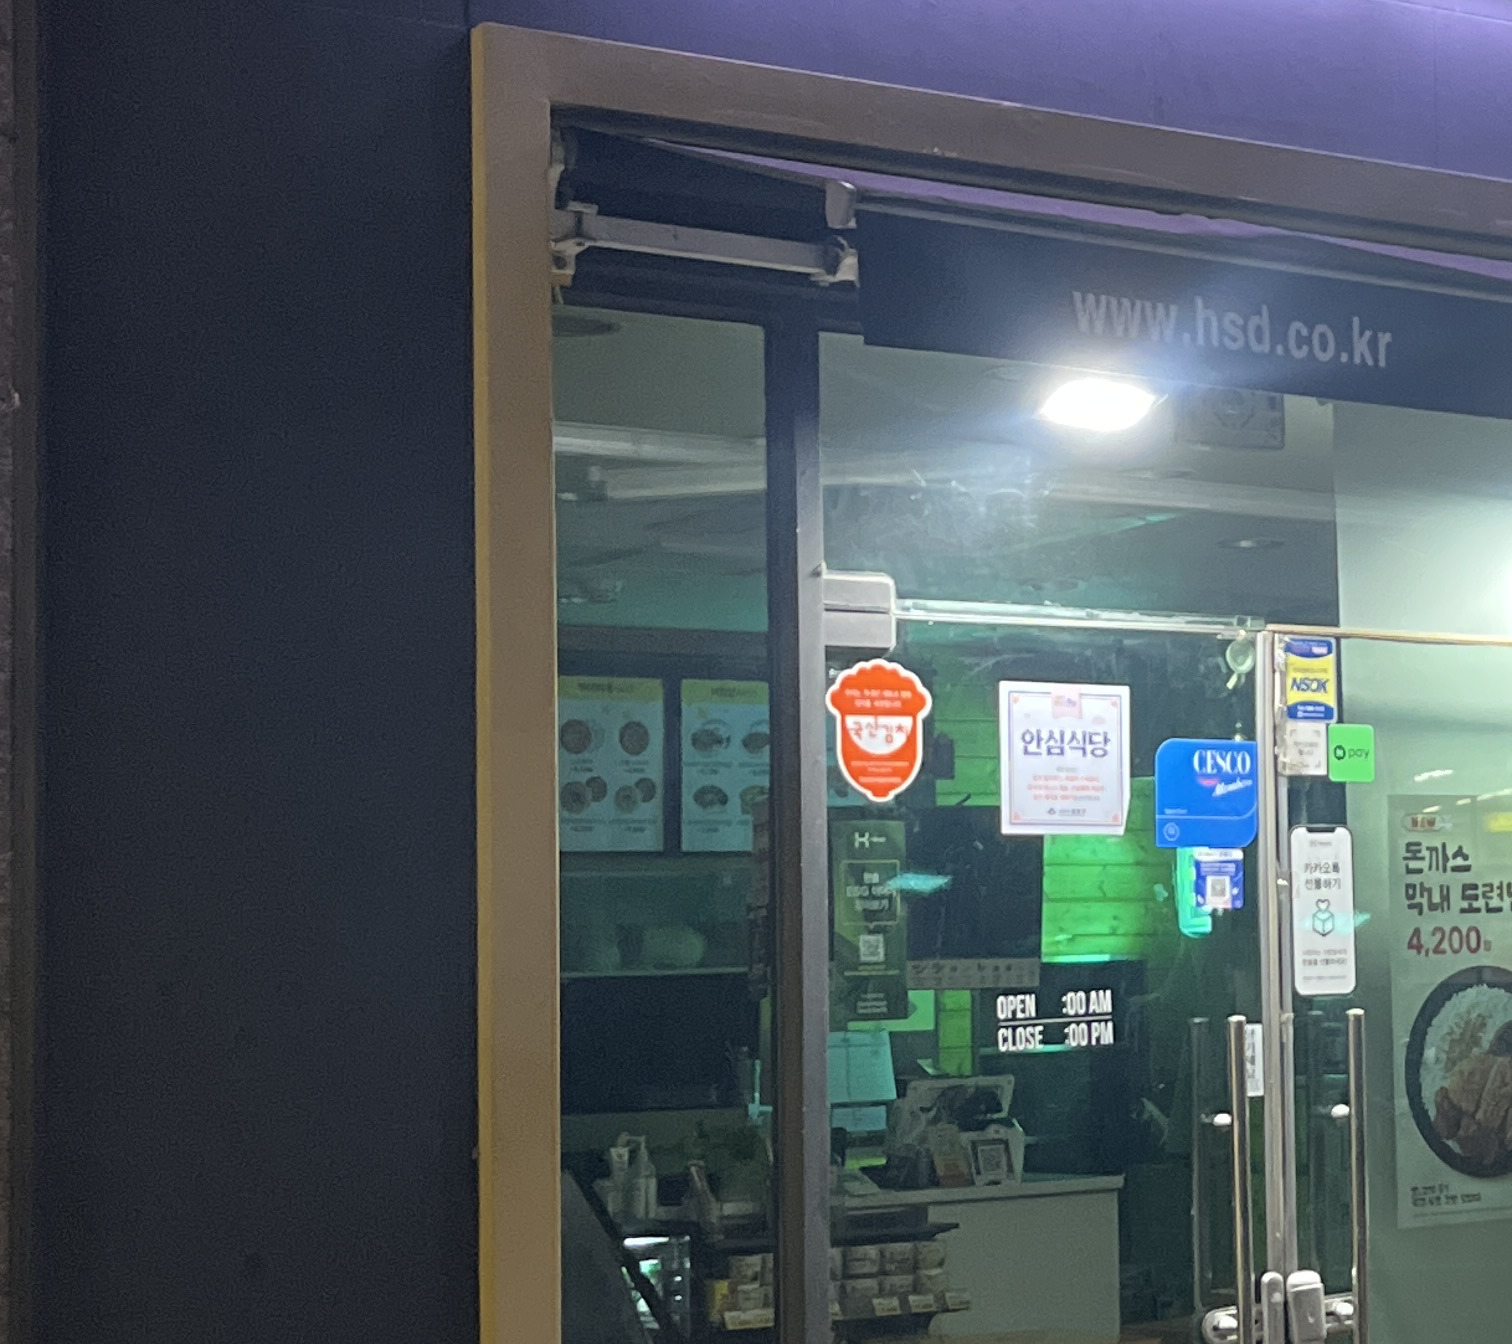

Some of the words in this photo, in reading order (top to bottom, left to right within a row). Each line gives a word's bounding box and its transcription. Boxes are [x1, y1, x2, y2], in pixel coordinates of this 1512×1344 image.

[1072, 291, 1392, 368] www.hsd.co.kr
[1021, 728, 1111, 758] 안심식당
[1348, 748, 1370, 759] pay
[1193, 748, 1251, 775] CESCO
[1402, 841, 1471, 875] 돈까스
[1404, 881, 1450, 916] 막내
[997, 993, 1036, 1019] OPEN
[1089, 989, 1112, 1013] AM
[997, 1025, 1043, 1052] CLOSE
[1091, 1021, 1114, 1046] PM
